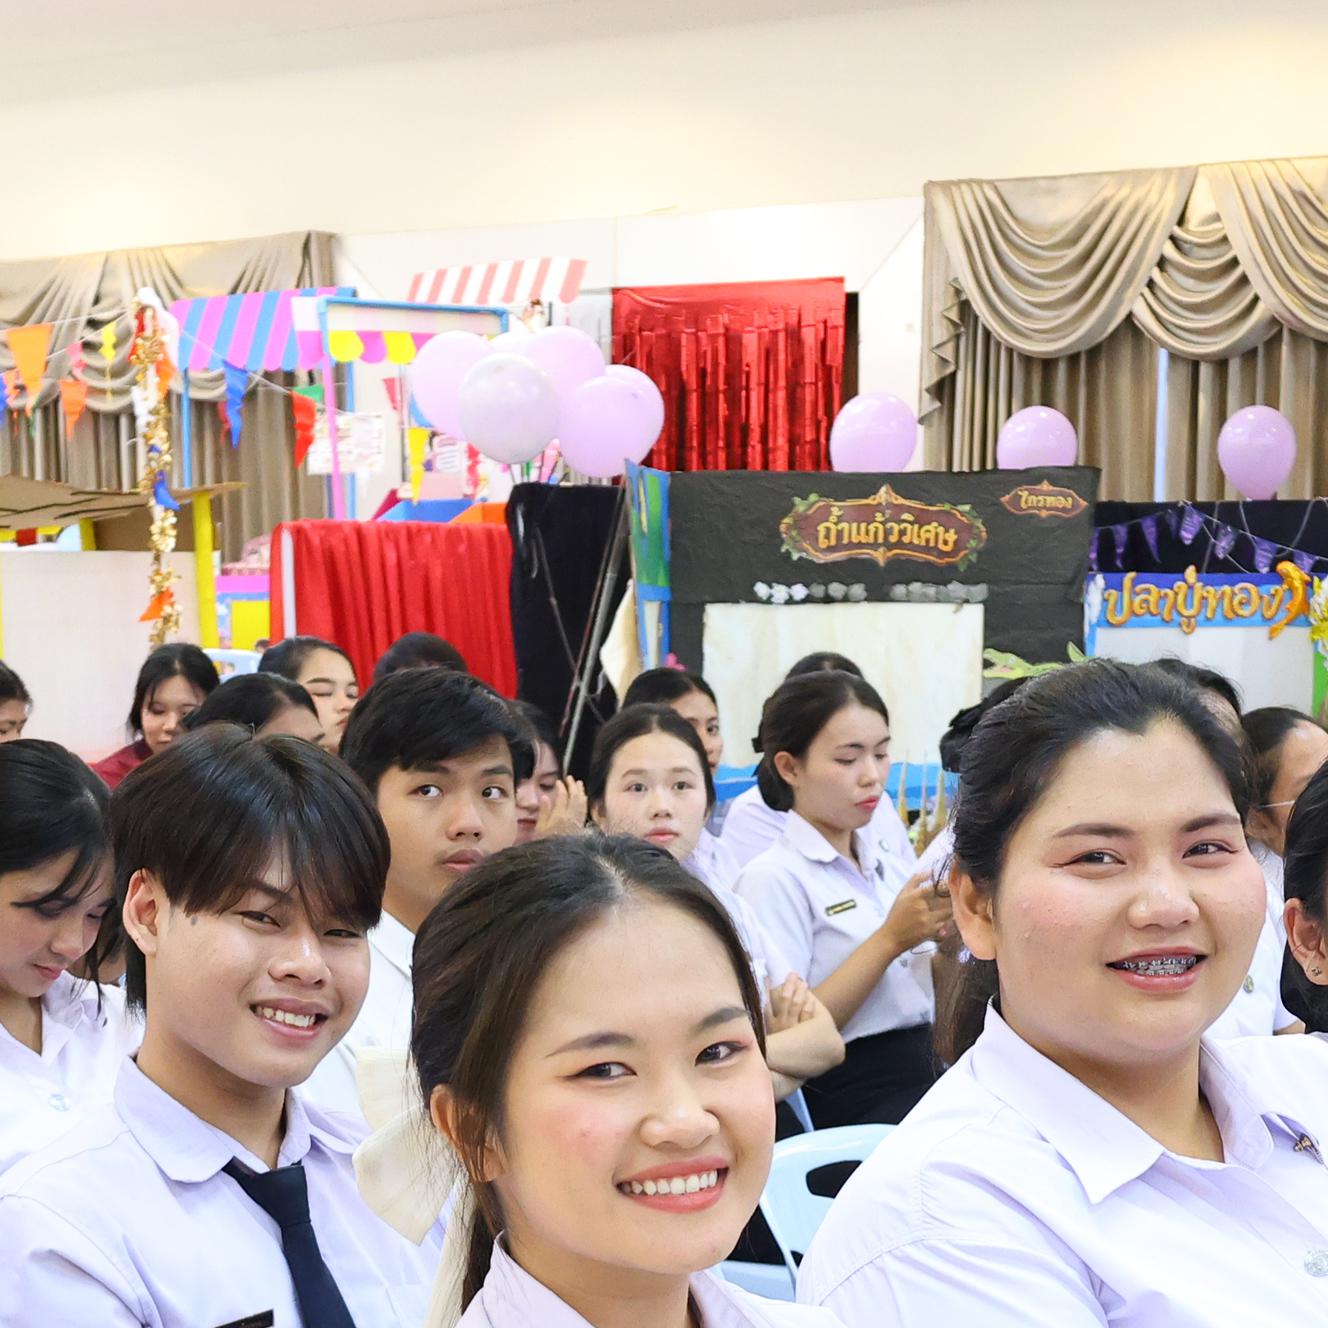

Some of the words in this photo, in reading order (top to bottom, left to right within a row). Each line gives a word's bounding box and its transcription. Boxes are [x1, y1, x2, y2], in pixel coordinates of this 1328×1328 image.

[817, 506, 958, 552] ถ้ำแก้ววิเศษ
[1104, 564, 1286, 635] ปลาบู่ทอง
